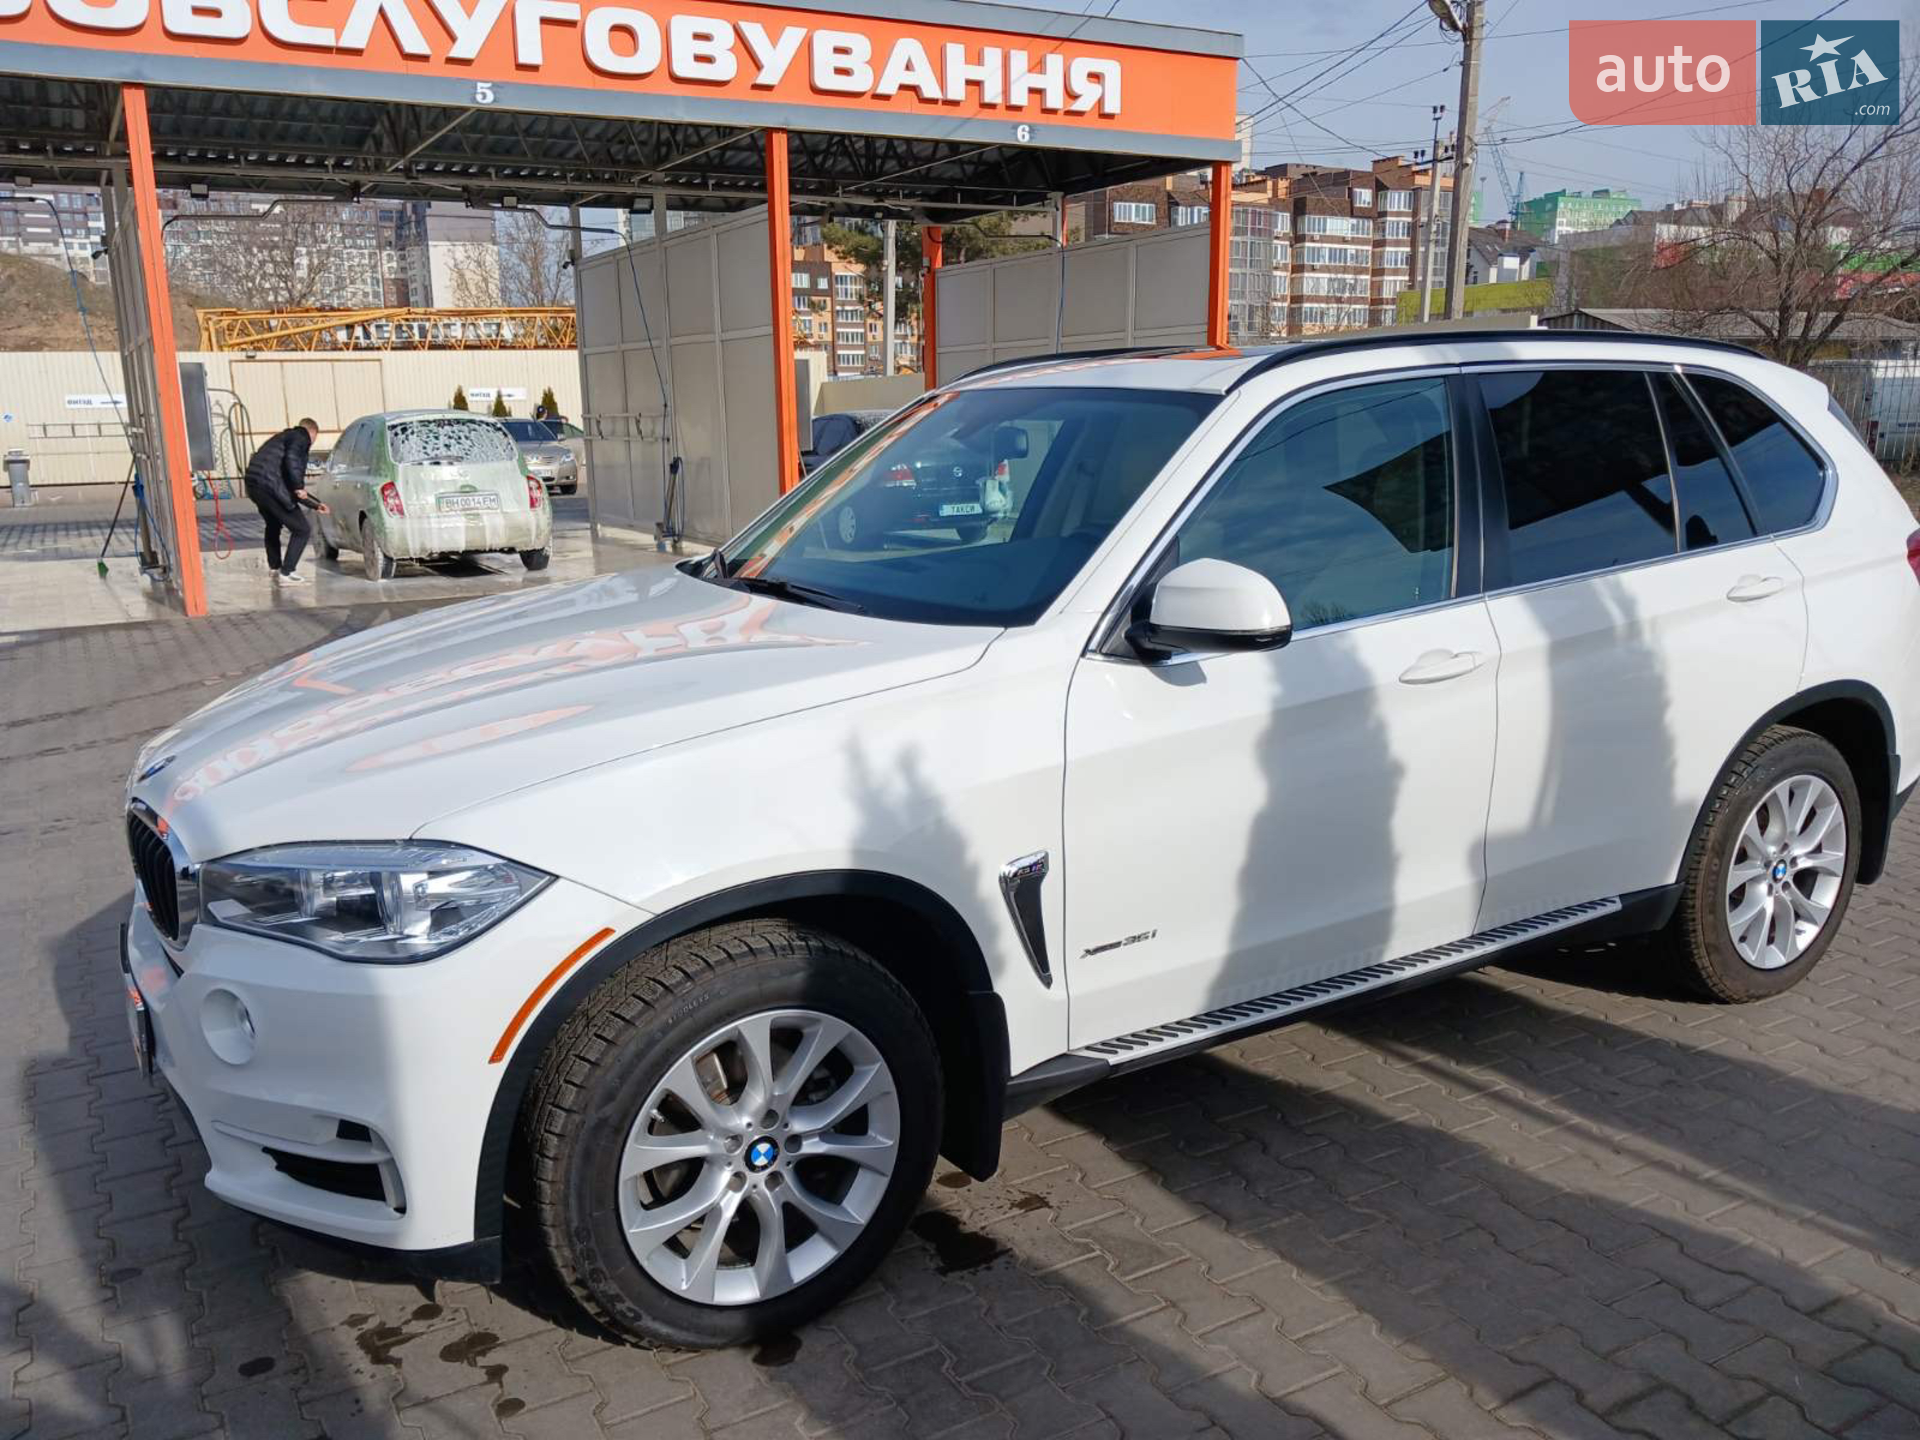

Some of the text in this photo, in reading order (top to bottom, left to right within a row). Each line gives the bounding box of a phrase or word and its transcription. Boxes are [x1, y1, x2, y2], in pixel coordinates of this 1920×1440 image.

[0, 0, 1122, 115] БСЛУГОВУВАННЯ
[475, 82, 494, 104] 5
[1017, 124, 1030, 142] 6
